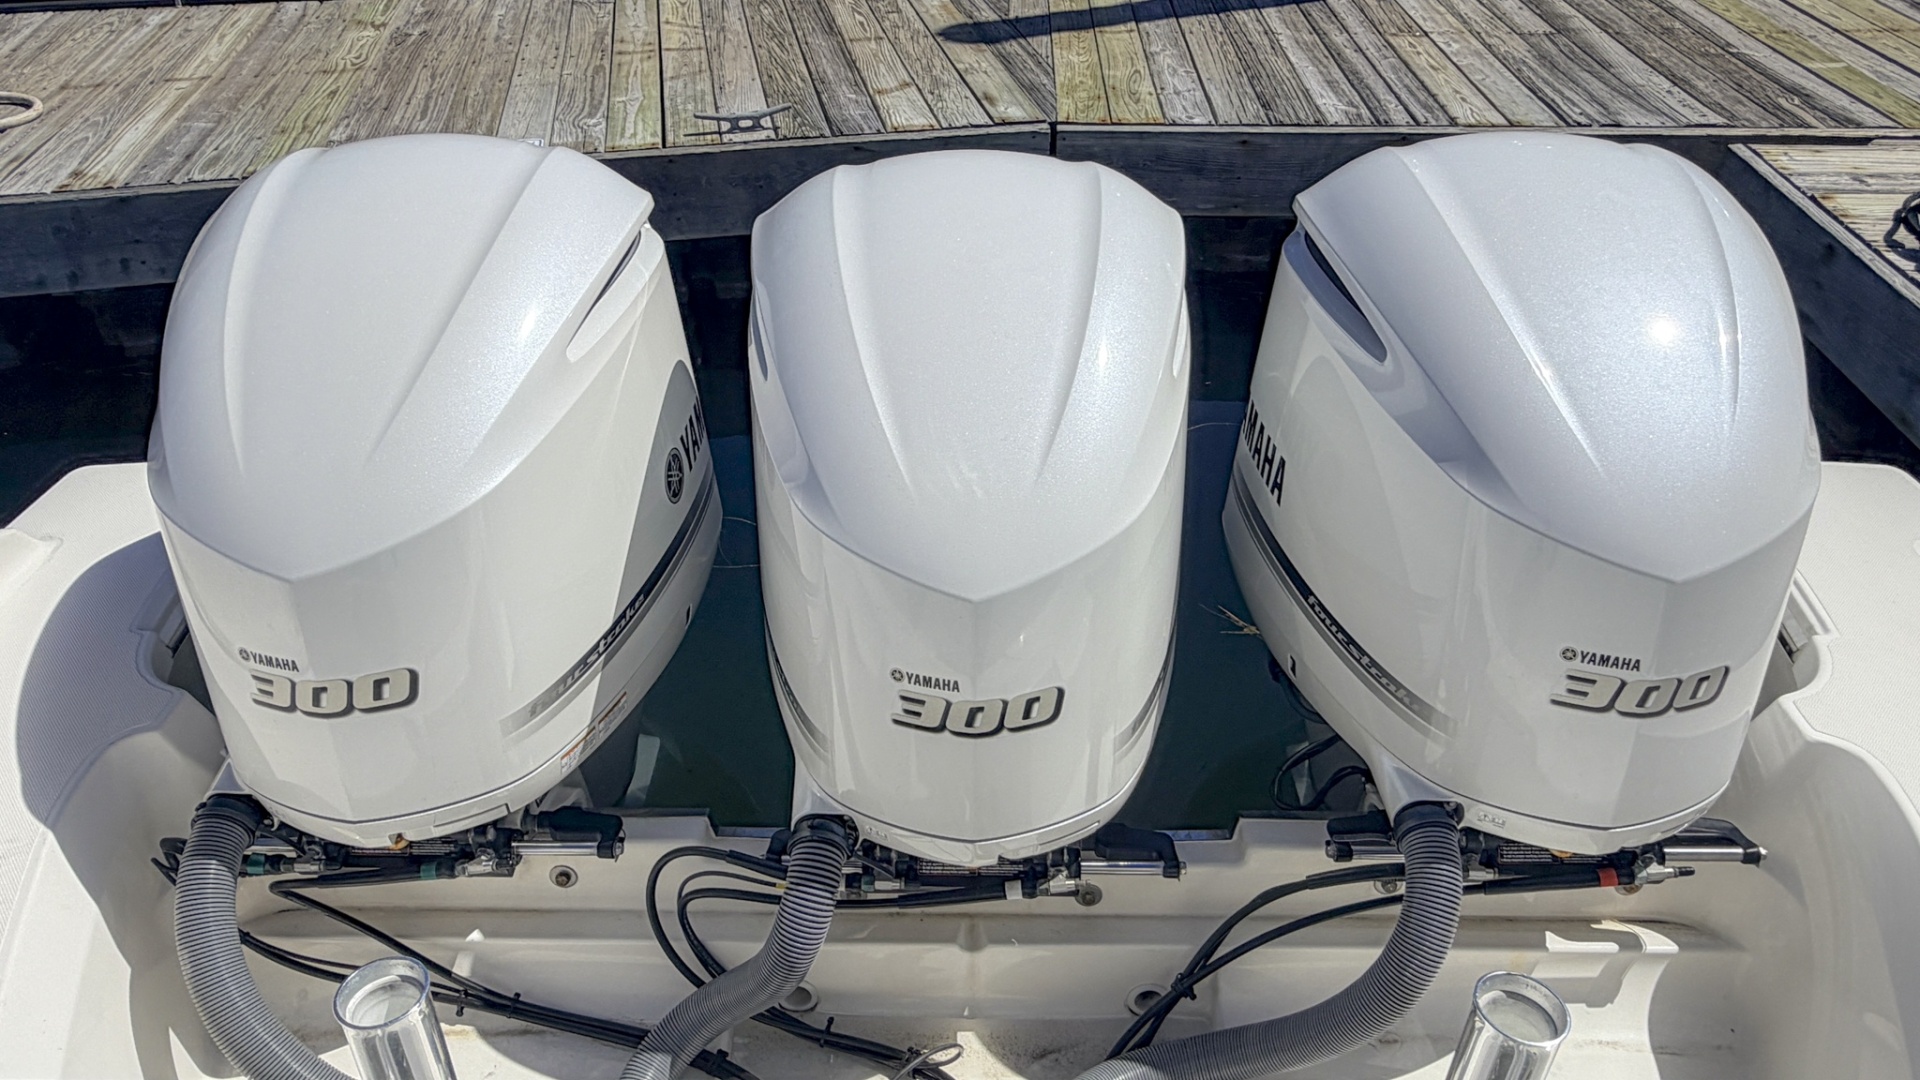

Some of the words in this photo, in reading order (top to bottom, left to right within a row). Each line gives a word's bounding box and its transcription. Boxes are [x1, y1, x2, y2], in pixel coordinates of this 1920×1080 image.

[250, 650, 300, 673] YAMAHA
[1579, 650, 1641, 672] YAMAHA
[250, 667, 420, 720] 300
[905, 671, 961, 693] YAMAHA
[1549, 664, 1731, 720] 300
[890, 685, 1066, 740] 300
